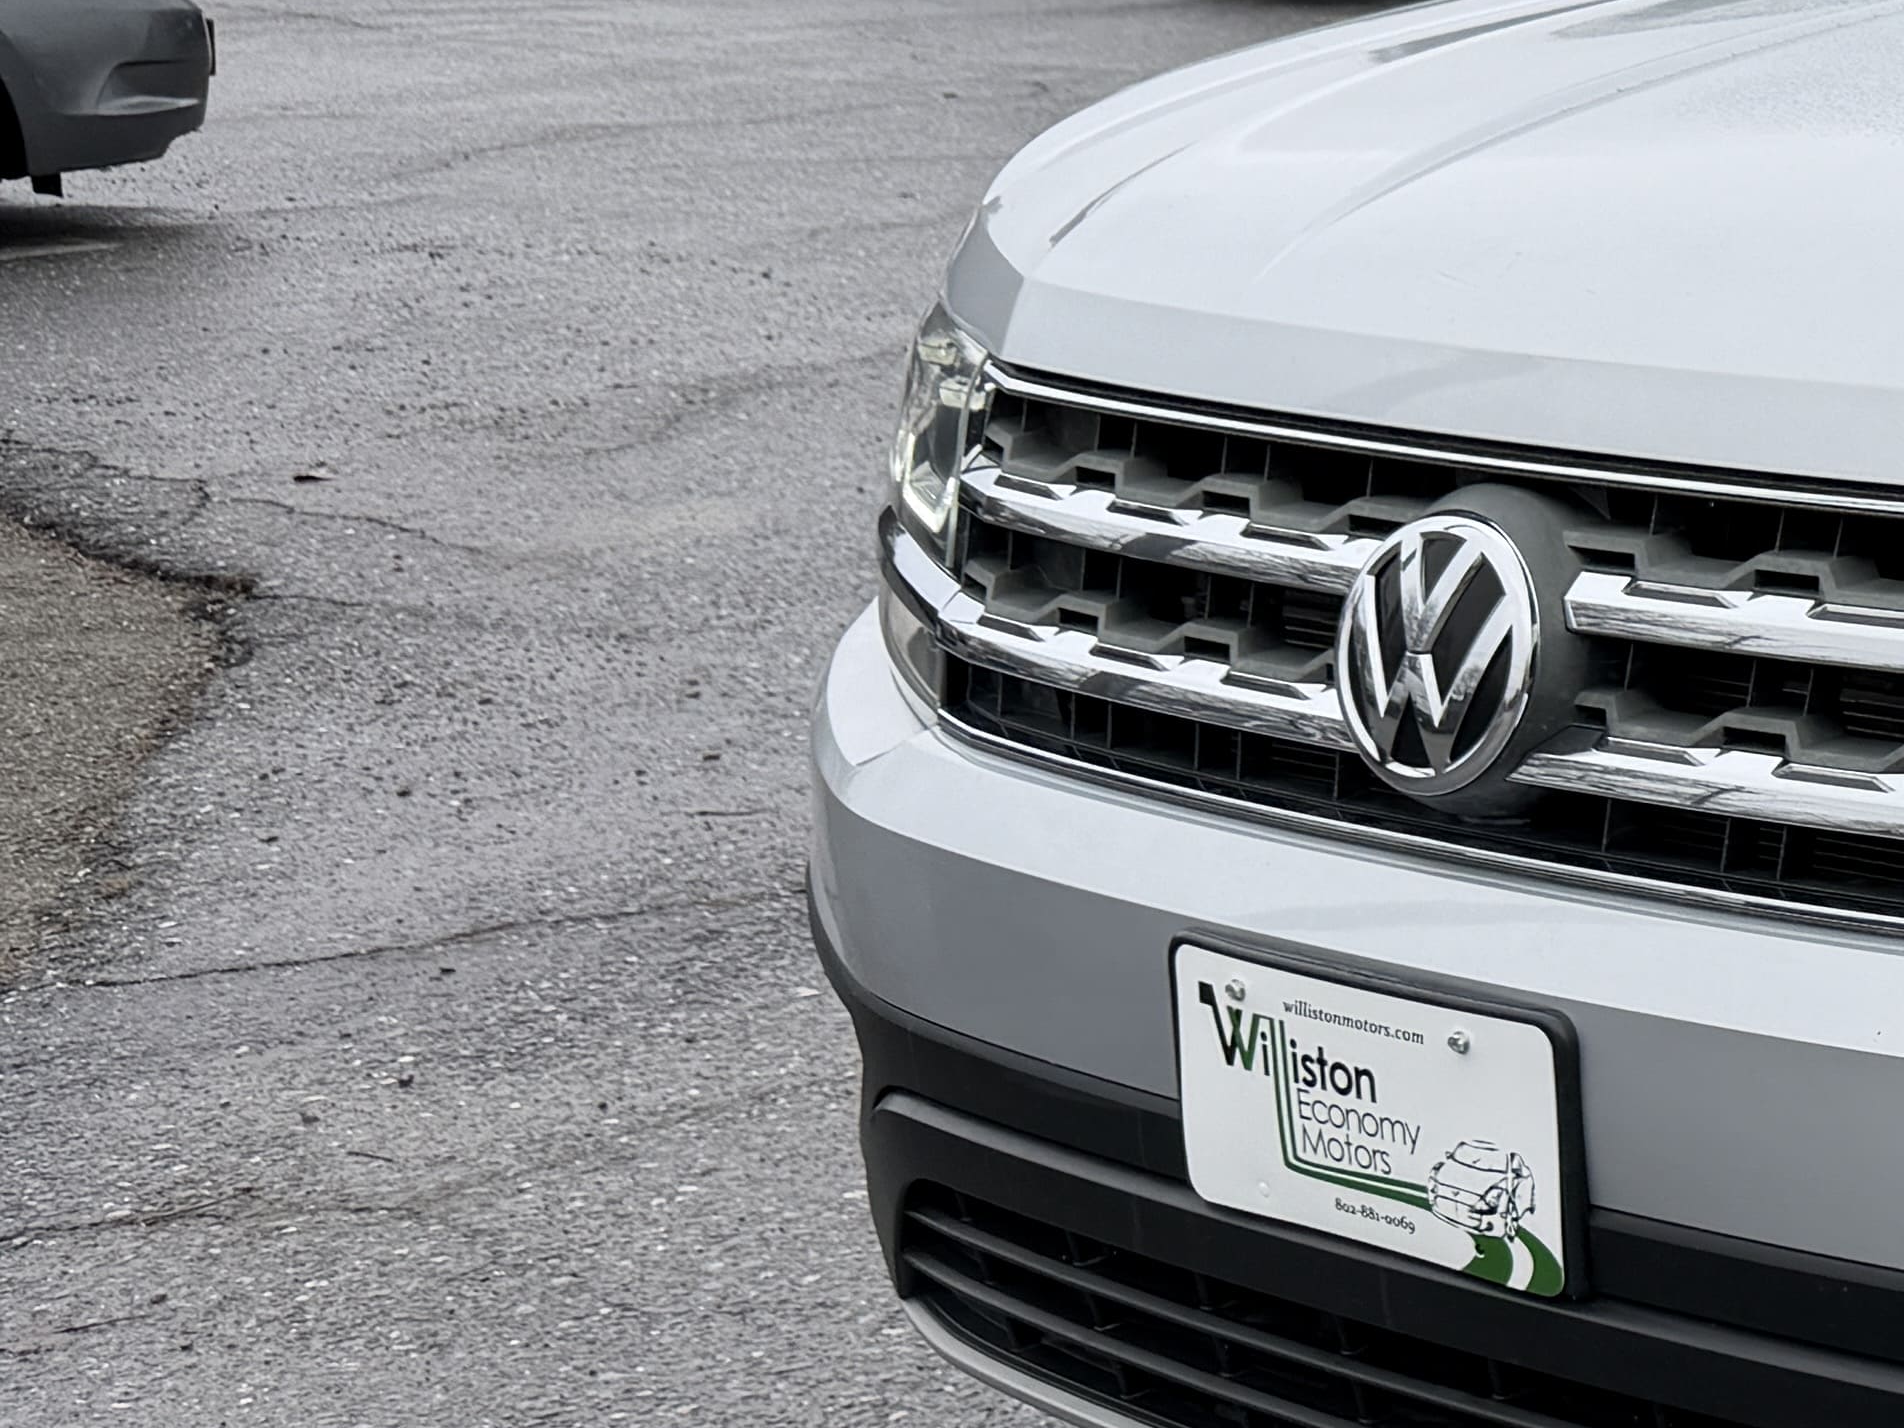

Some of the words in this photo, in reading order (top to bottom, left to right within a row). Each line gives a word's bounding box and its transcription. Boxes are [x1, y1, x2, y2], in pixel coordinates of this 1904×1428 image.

[1343, 520, 1530, 784] VW
[1198, 980, 1378, 1105] Williston
[1283, 999, 1425, 1045] willistonmotors.com
[1298, 1089, 1421, 1154] Economy
[1301, 1124, 1392, 1176] Motors
[1334, 1197, 1416, 1235] 802-881-0069
